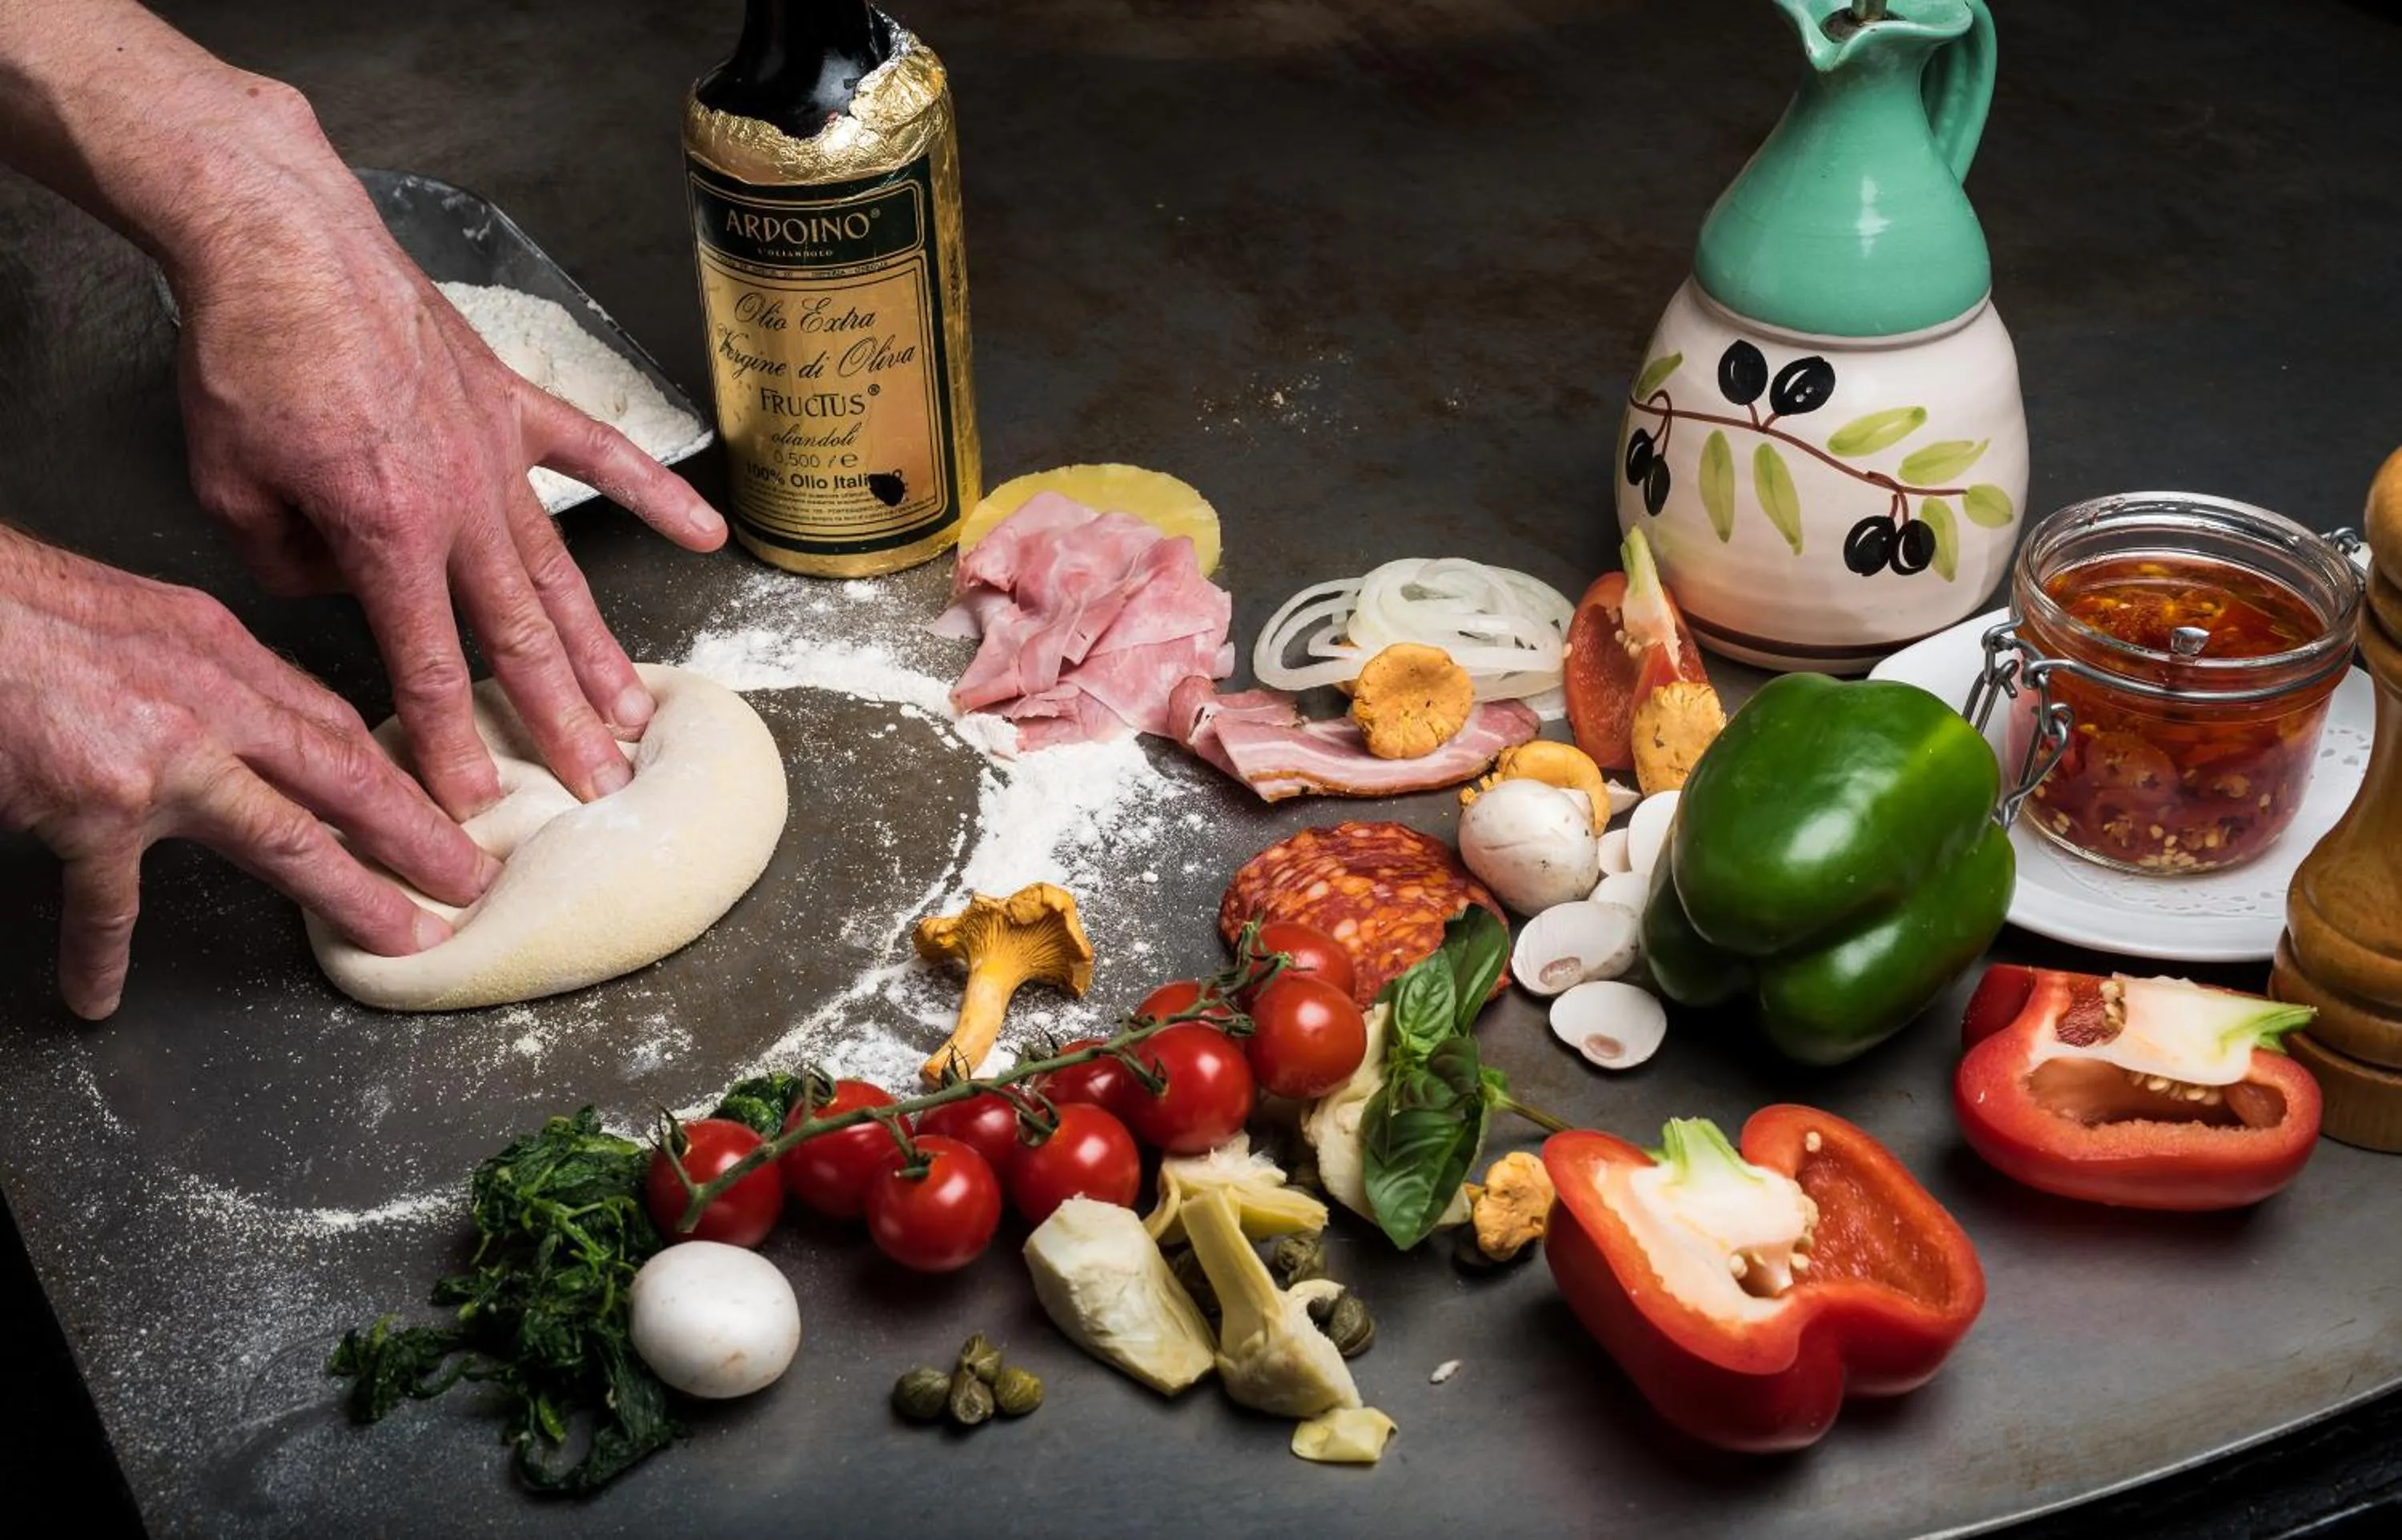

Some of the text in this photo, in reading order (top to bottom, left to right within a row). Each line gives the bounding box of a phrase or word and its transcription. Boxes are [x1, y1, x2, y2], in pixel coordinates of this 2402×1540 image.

[734, 292, 875, 334] Olio Extra
[717, 323, 916, 380] Vergine di Oliva
[746, 461, 903, 491] 100% Olio Italio
